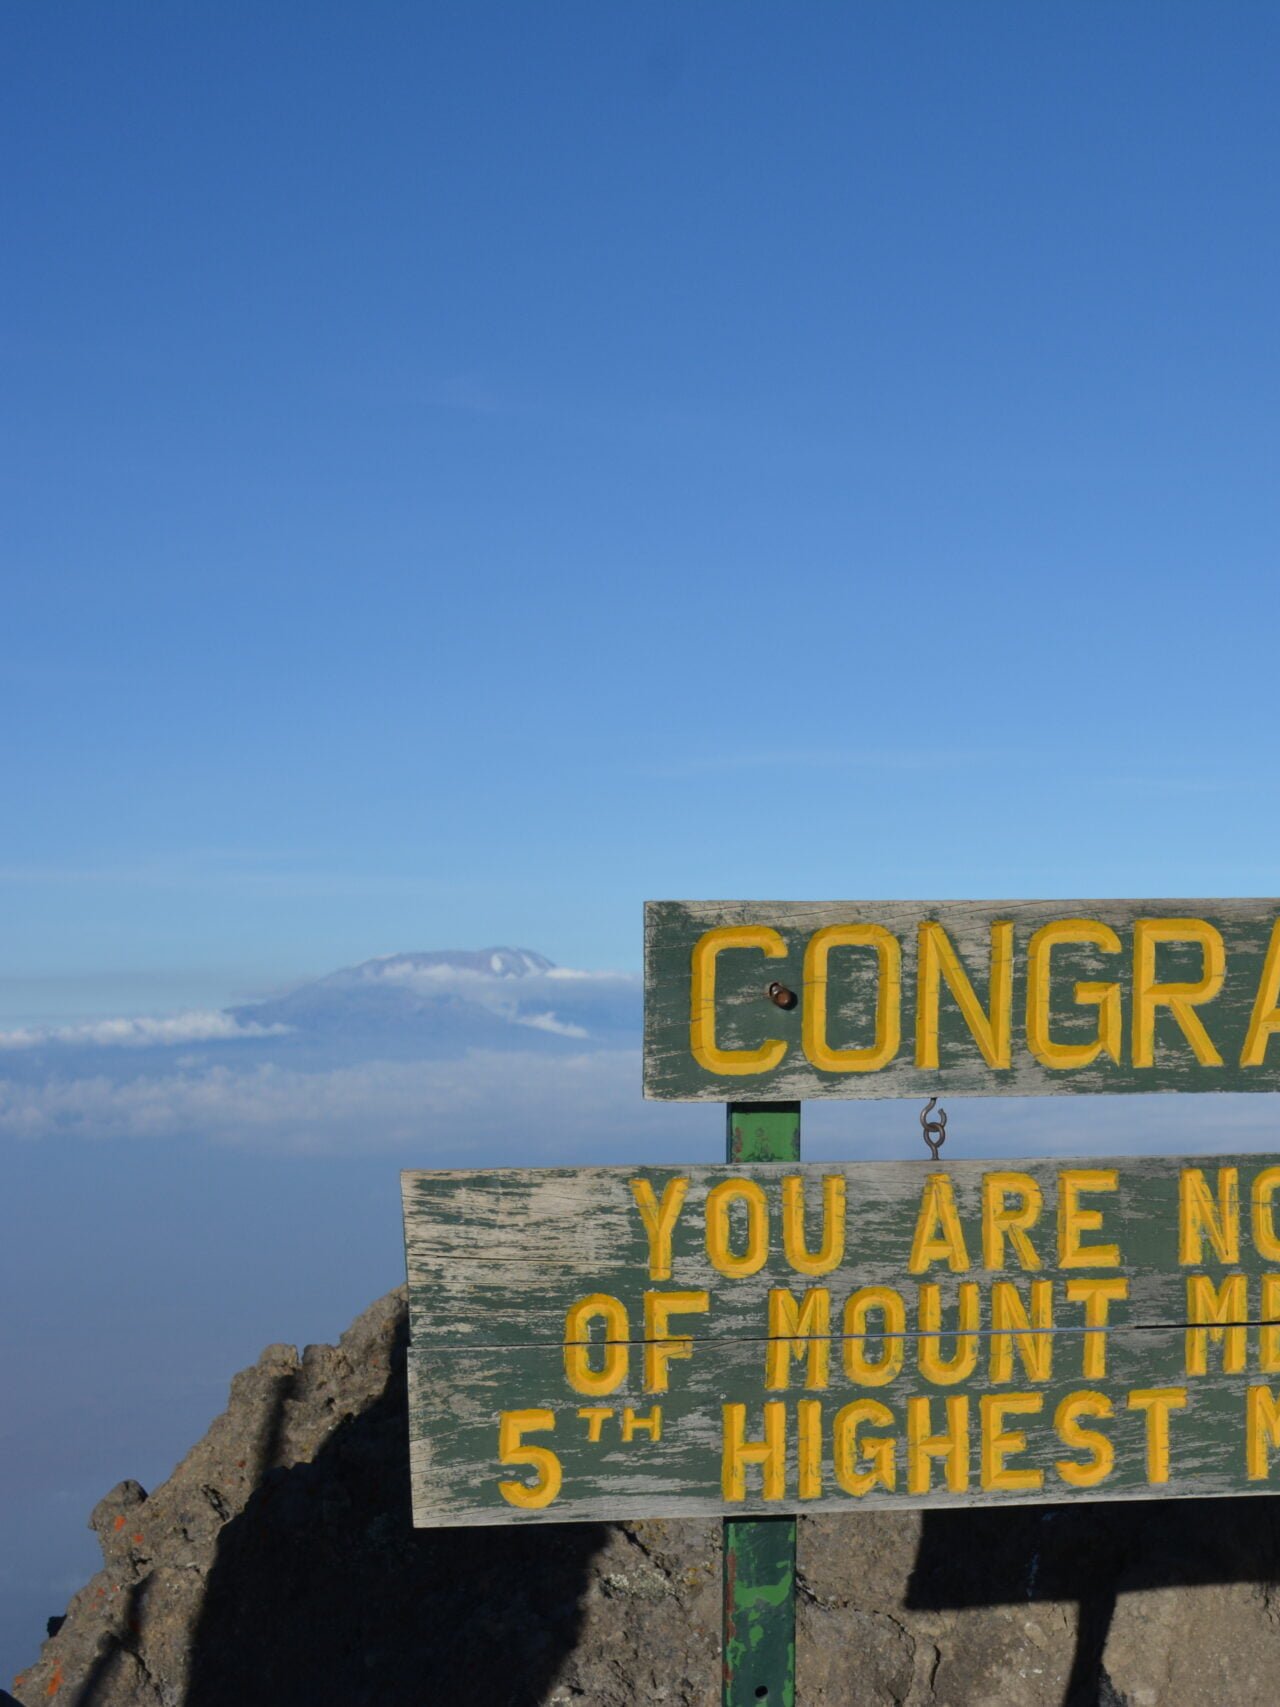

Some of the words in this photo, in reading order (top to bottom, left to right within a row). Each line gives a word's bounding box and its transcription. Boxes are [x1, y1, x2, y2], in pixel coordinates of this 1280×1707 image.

[631, 1175, 846, 1280] YOU
[908, 1169, 1120, 1273] ARE
[564, 1291, 709, 1395] OF
[764, 1278, 1130, 1391] MOUNT
[722, 1386, 1188, 1501] HIGHEST
